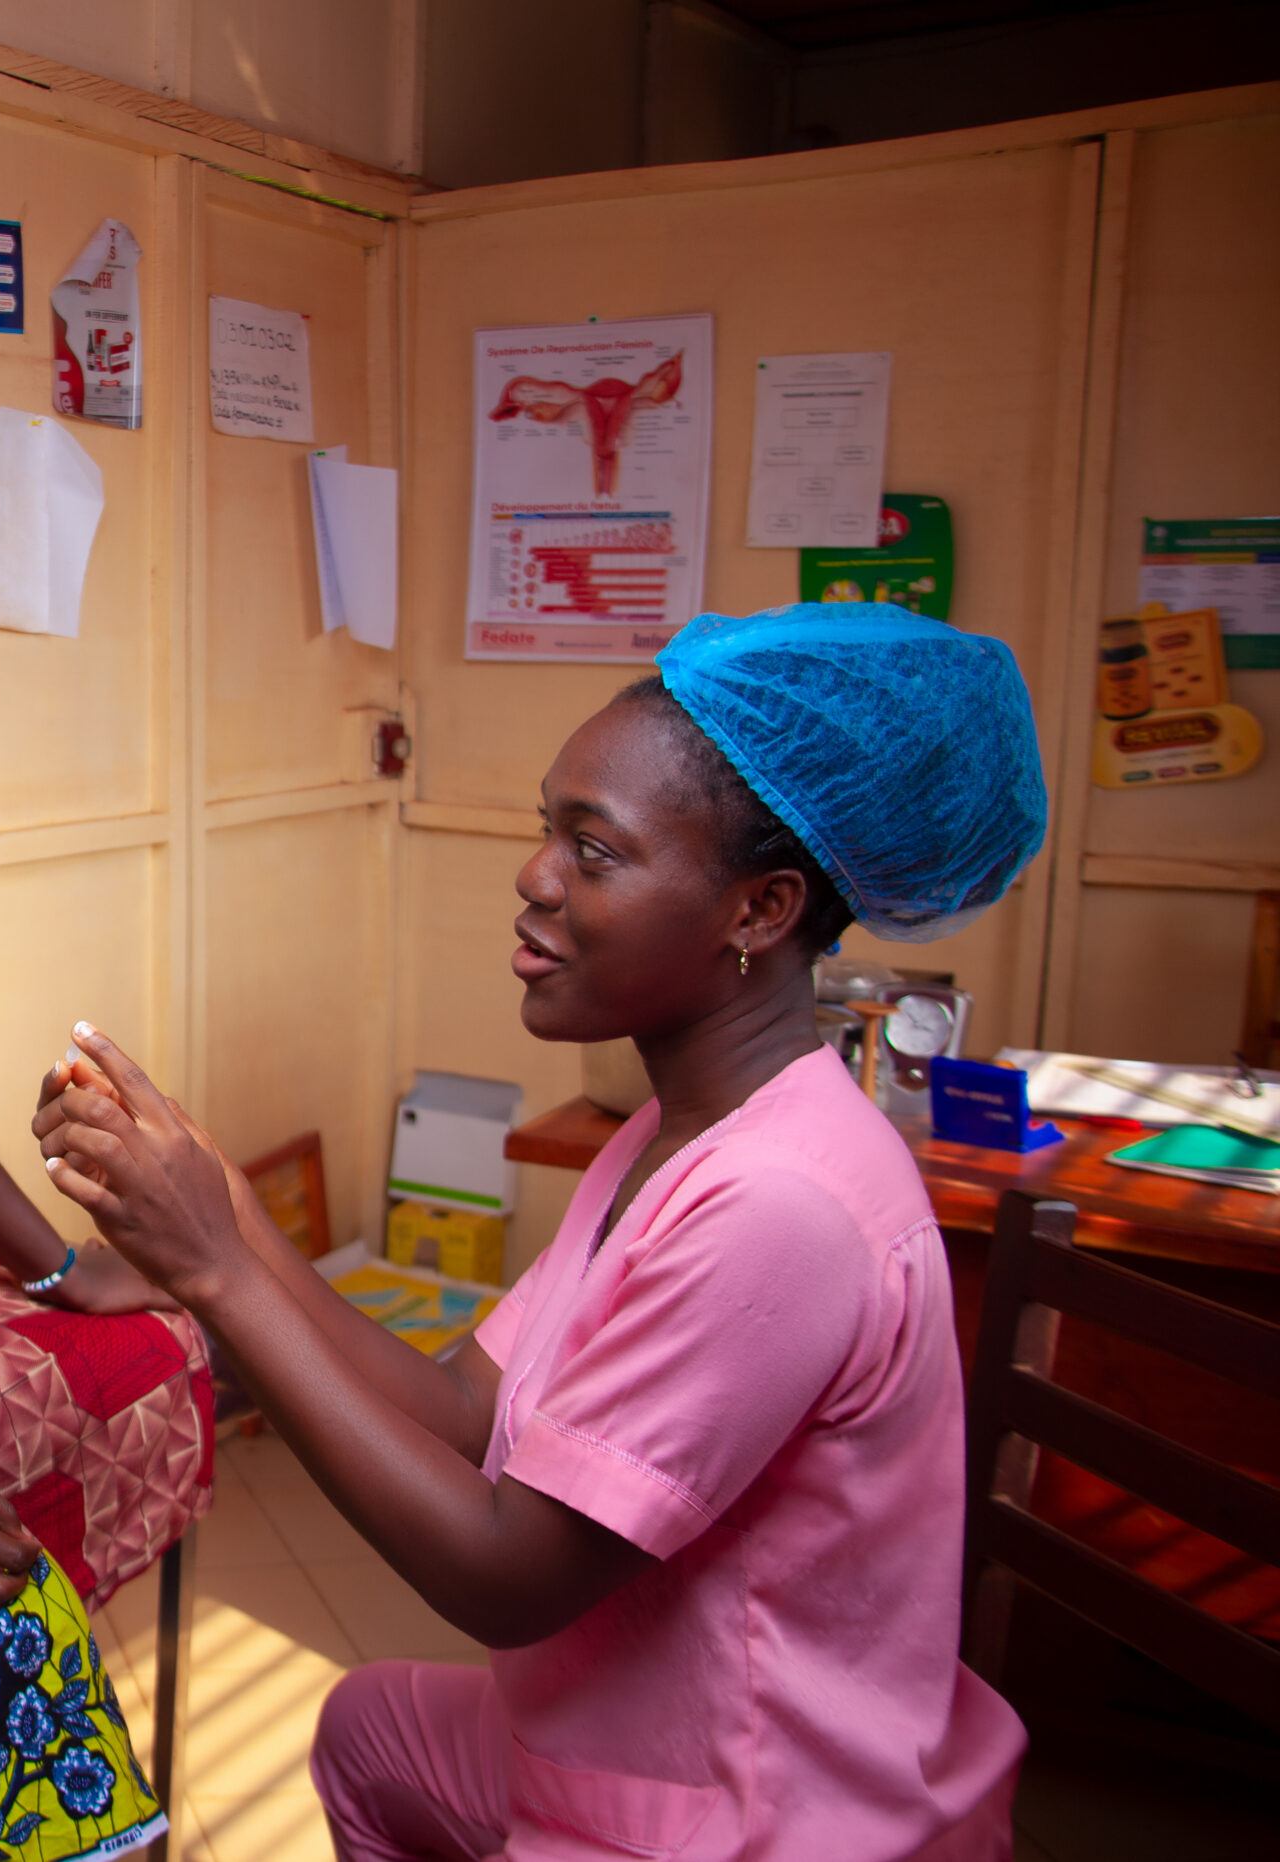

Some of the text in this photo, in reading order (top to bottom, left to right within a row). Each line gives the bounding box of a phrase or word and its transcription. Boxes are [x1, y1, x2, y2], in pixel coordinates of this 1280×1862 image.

[546, 342, 613, 355] Reproduction
[490, 501, 571, 514] Développement
[575, 501, 589, 511] du
